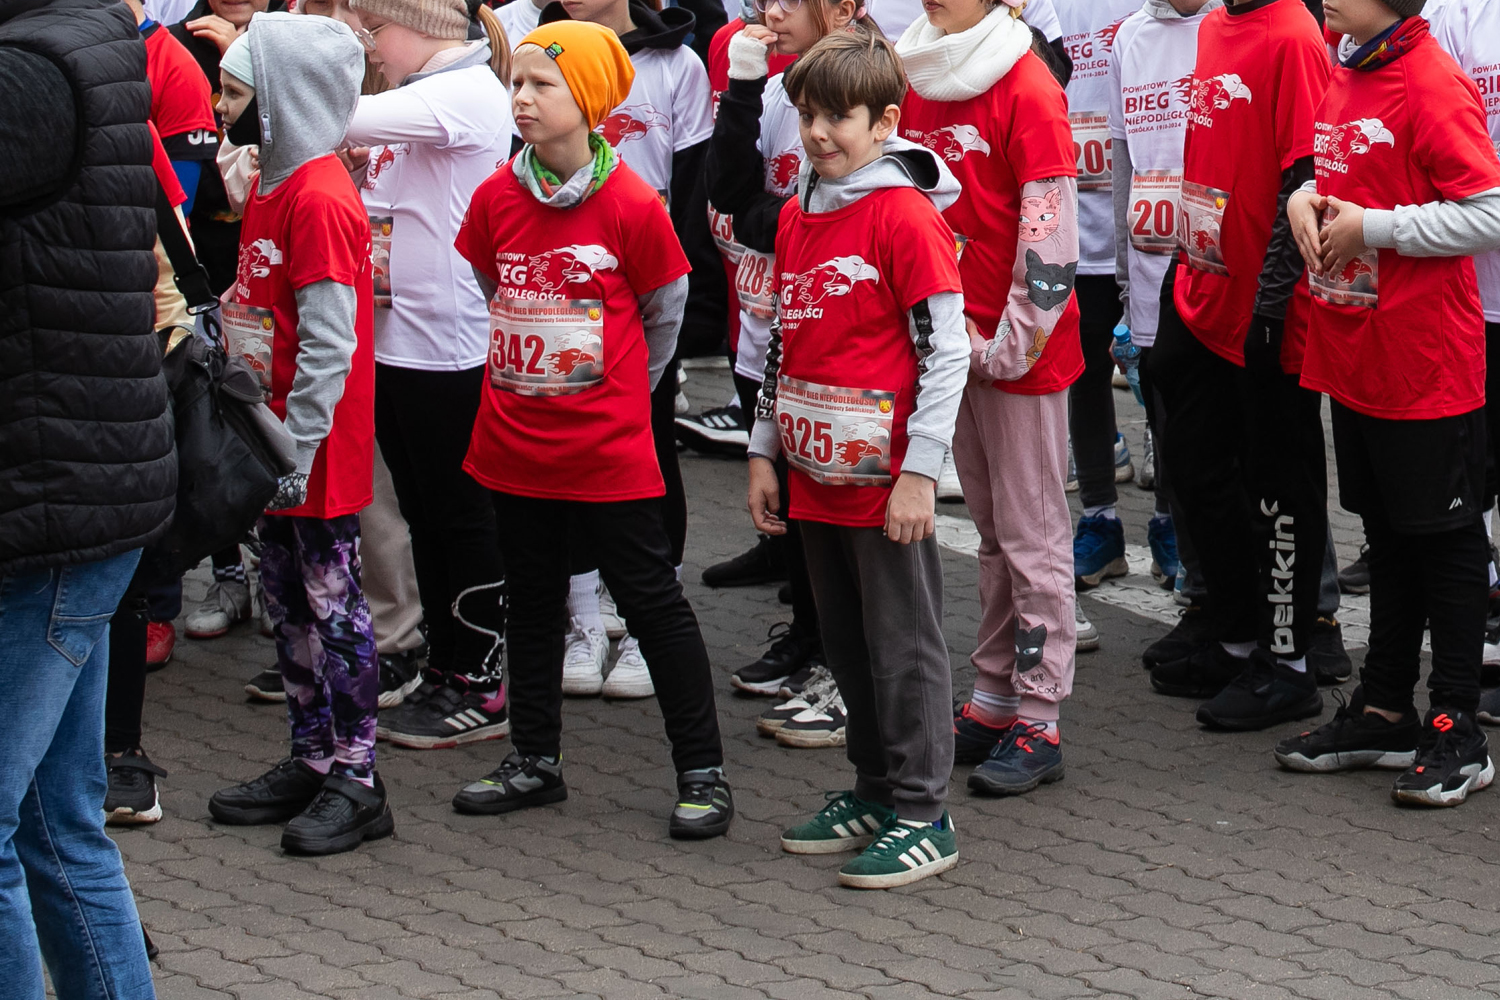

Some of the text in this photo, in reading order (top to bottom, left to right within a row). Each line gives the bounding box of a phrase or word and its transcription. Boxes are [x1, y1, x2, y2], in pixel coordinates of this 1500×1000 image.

[1123, 81, 1168, 94] POWIATOWY
[1125, 91, 1170, 114] BIEG
[1125, 110, 1190, 127] NIEPODLEGŁO
[1128, 125, 1154, 135] SOKÓŁKA
[1134, 175, 1181, 184] POWIATOWY BIEG
[1133, 199, 1177, 238] 20
[737, 257, 768, 296] 228
[493, 329, 546, 375] 342
[807, 390, 819, 400] BIEG
[825, 403, 845, 412] Starosty
[779, 412, 833, 464] 325
[1267, 514, 1295, 655] bekkin
